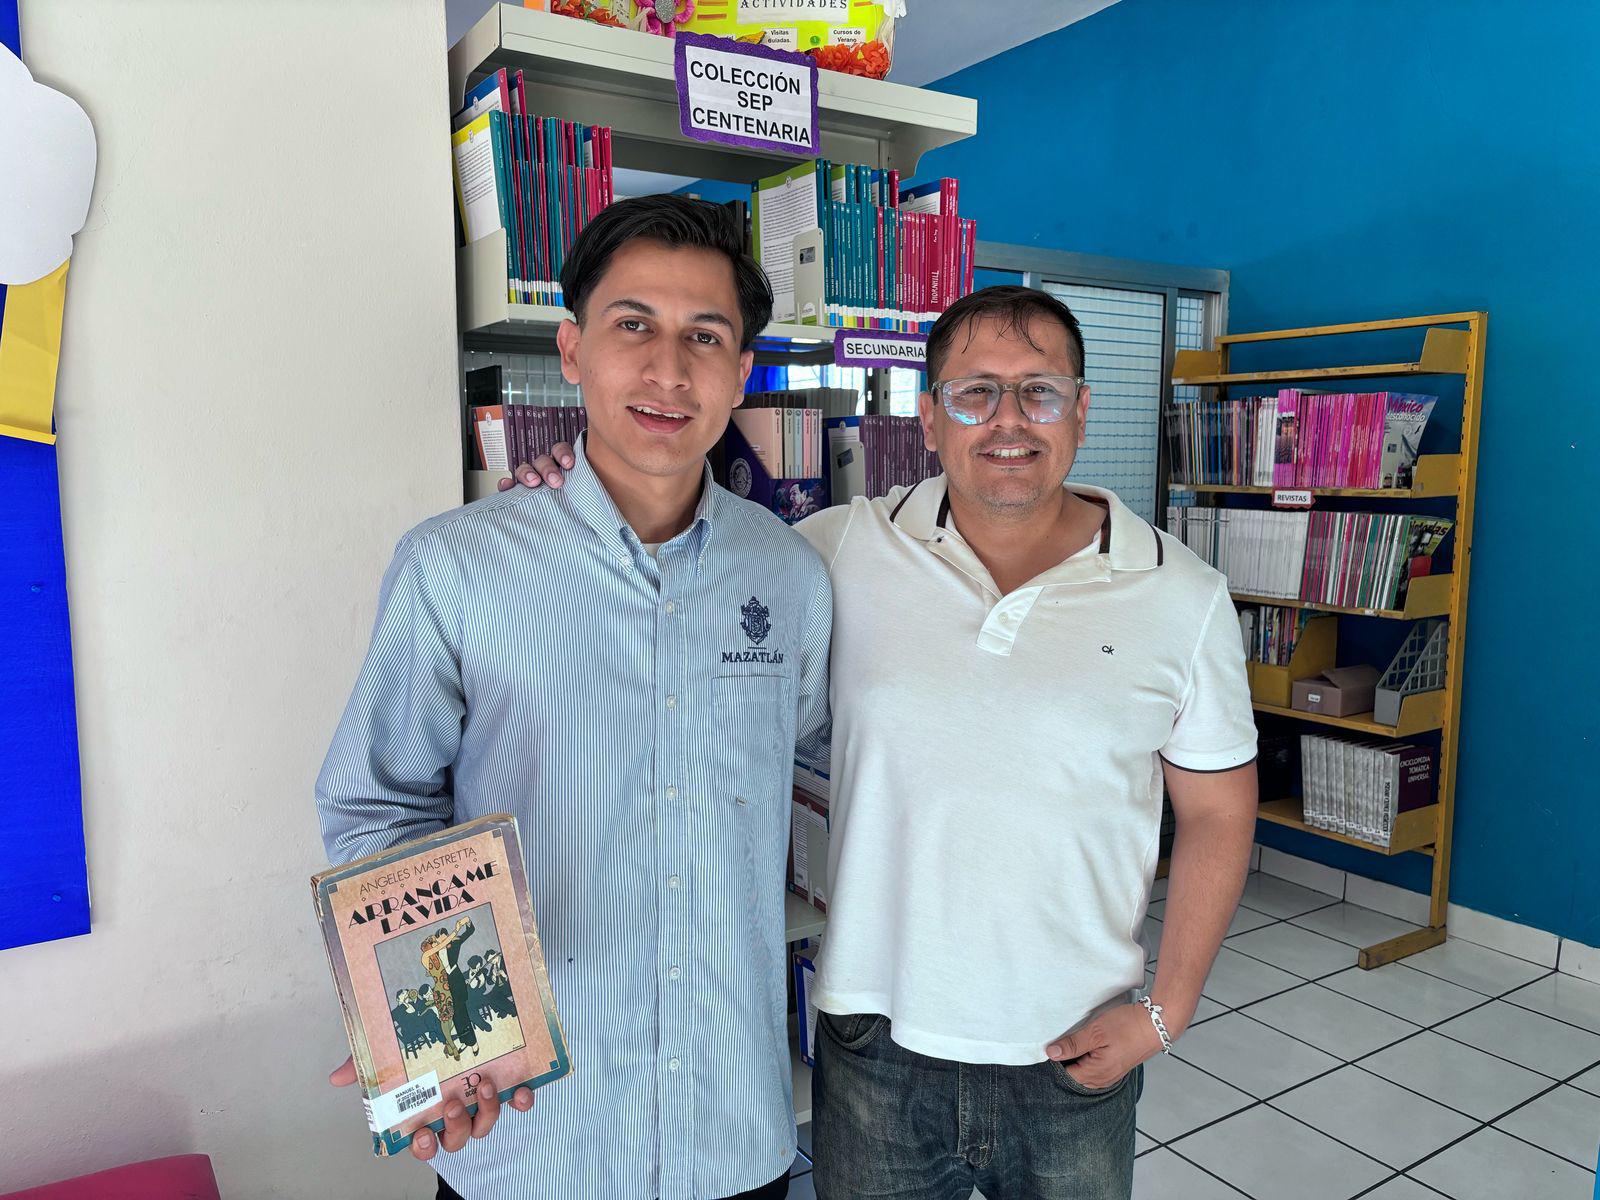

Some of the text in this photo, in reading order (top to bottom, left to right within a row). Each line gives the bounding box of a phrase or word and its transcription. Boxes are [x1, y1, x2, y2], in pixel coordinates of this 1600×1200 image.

[740, 0, 847, 9] ACTIVIDADES
[690, 60, 801, 95] COLECCIÓN
[737, 91, 773, 111] SEP
[692, 107, 811, 144] CENTENARIA
[846, 343, 926, 358] SECUNDARIA
[1277, 494, 1307, 502] REVISTAS
[722, 648, 784, 664] MAZATLÁN
[359, 846, 477, 896] ANGELES MASTRETTA
[349, 860, 501, 929] ARRANCAME
[380, 888, 476, 935] LA VIDA
[395, 1086, 414, 1099] MANUEL
